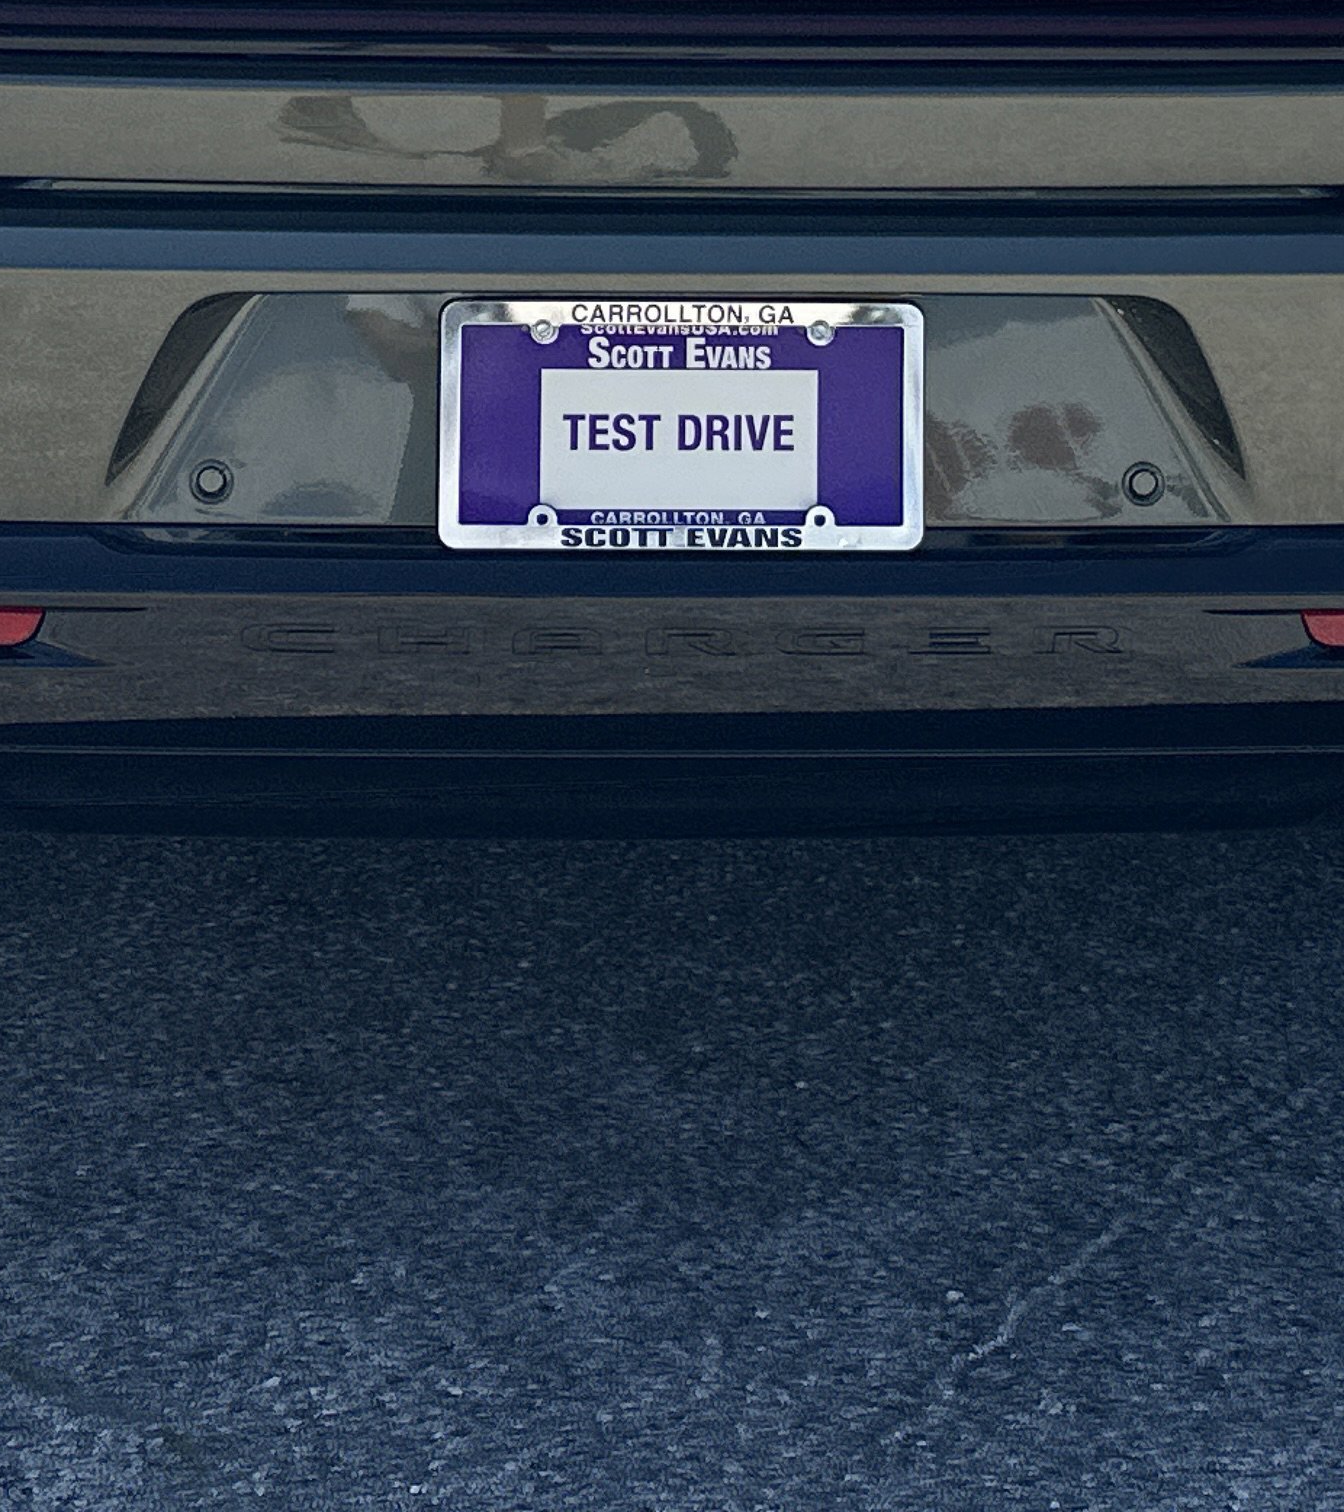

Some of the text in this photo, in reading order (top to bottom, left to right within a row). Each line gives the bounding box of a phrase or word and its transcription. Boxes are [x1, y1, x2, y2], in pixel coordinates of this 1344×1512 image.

[571, 303, 795, 324] CARROLLTON, GA
[562, 413, 795, 452] TEST DRIVE
[737, 511, 767, 525] GA
[560, 527, 803, 548] SCOTT EVANS
[240, 622, 1134, 658] CHARGER
